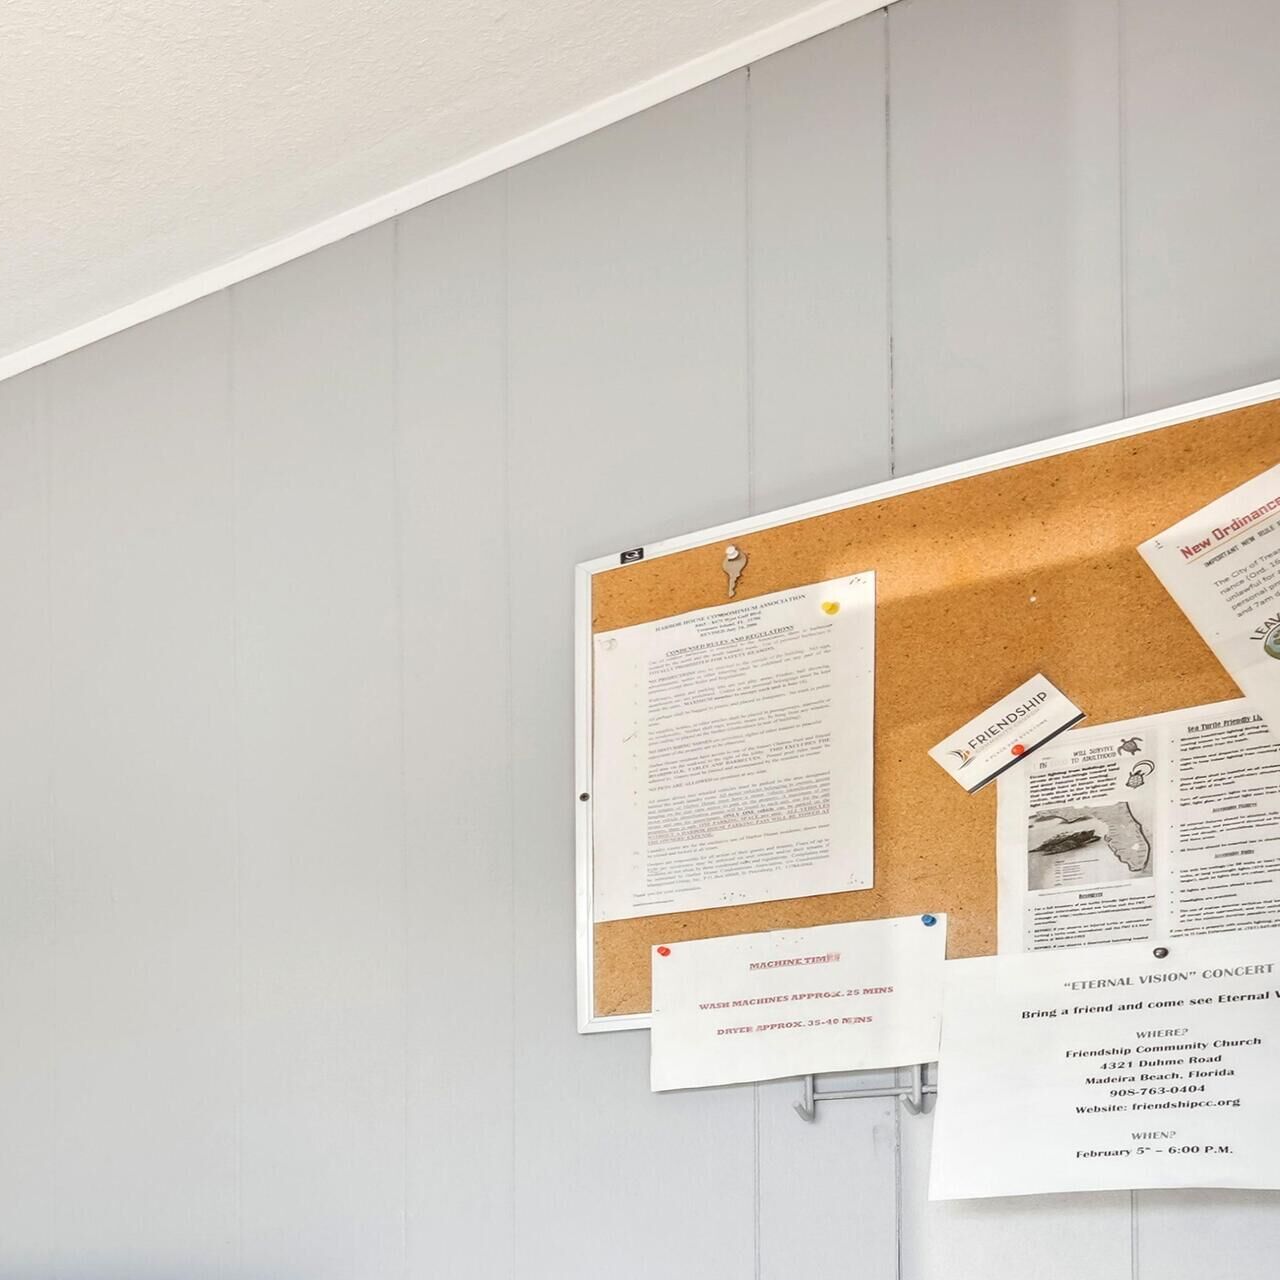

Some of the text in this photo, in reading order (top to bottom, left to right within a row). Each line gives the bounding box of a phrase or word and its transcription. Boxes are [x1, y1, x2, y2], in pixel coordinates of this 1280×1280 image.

[1180, 538, 1211, 559] New
[1204, 545, 1239, 567] IMPORTANT
[1214, 577, 1229, 587] The
[1231, 567, 1247, 577] City
[1249, 560, 1257, 568] of
[1226, 581, 1261, 601] unlawful
[1232, 588, 1267, 610] personal
[1238, 606, 1253, 617] and
[968, 692, 1047, 749] FRIENDSHIP
[1201, 722, 1221, 730] Turtle
[1224, 716, 1251, 726] Friendly
[749, 952, 840, 970] MACHINE TIM
[1202, 963, 1275, 979] CONCERT
[699, 1002, 730, 1010] WASH
[732, 995, 789, 1007] MACHINES
[863, 986, 894, 995] MINS
[1022, 1008, 1056, 1019] Bring
[1074, 1004, 1113, 1014] friend
[1118, 1002, 1142, 1011] and
[1148, 999, 1184, 1008] come
[1189, 996, 1212, 1005] see
[1218, 991, 1269, 1003] Eternal
[1136, 1028, 1188, 1039] WHERE?
[1066, 1038, 1261, 1058] Friendship Community Church
[1100, 1055, 1222, 1070] 4321 Duhme Road
[1086, 1076, 1135, 1085] Madeira
[1188, 1069, 1235, 1078] Florida
[1110, 1085, 1205, 1097] 908-763-0404
[1076, 1098, 1240, 1114] Website: friendshipcc.org
[1131, 1131, 1176, 1140] WHEN?
[1076, 1149, 1132, 1158] February
[1168, 1146, 1199, 1154] 6:00
[1205, 1146, 1233, 1154] P.M.
